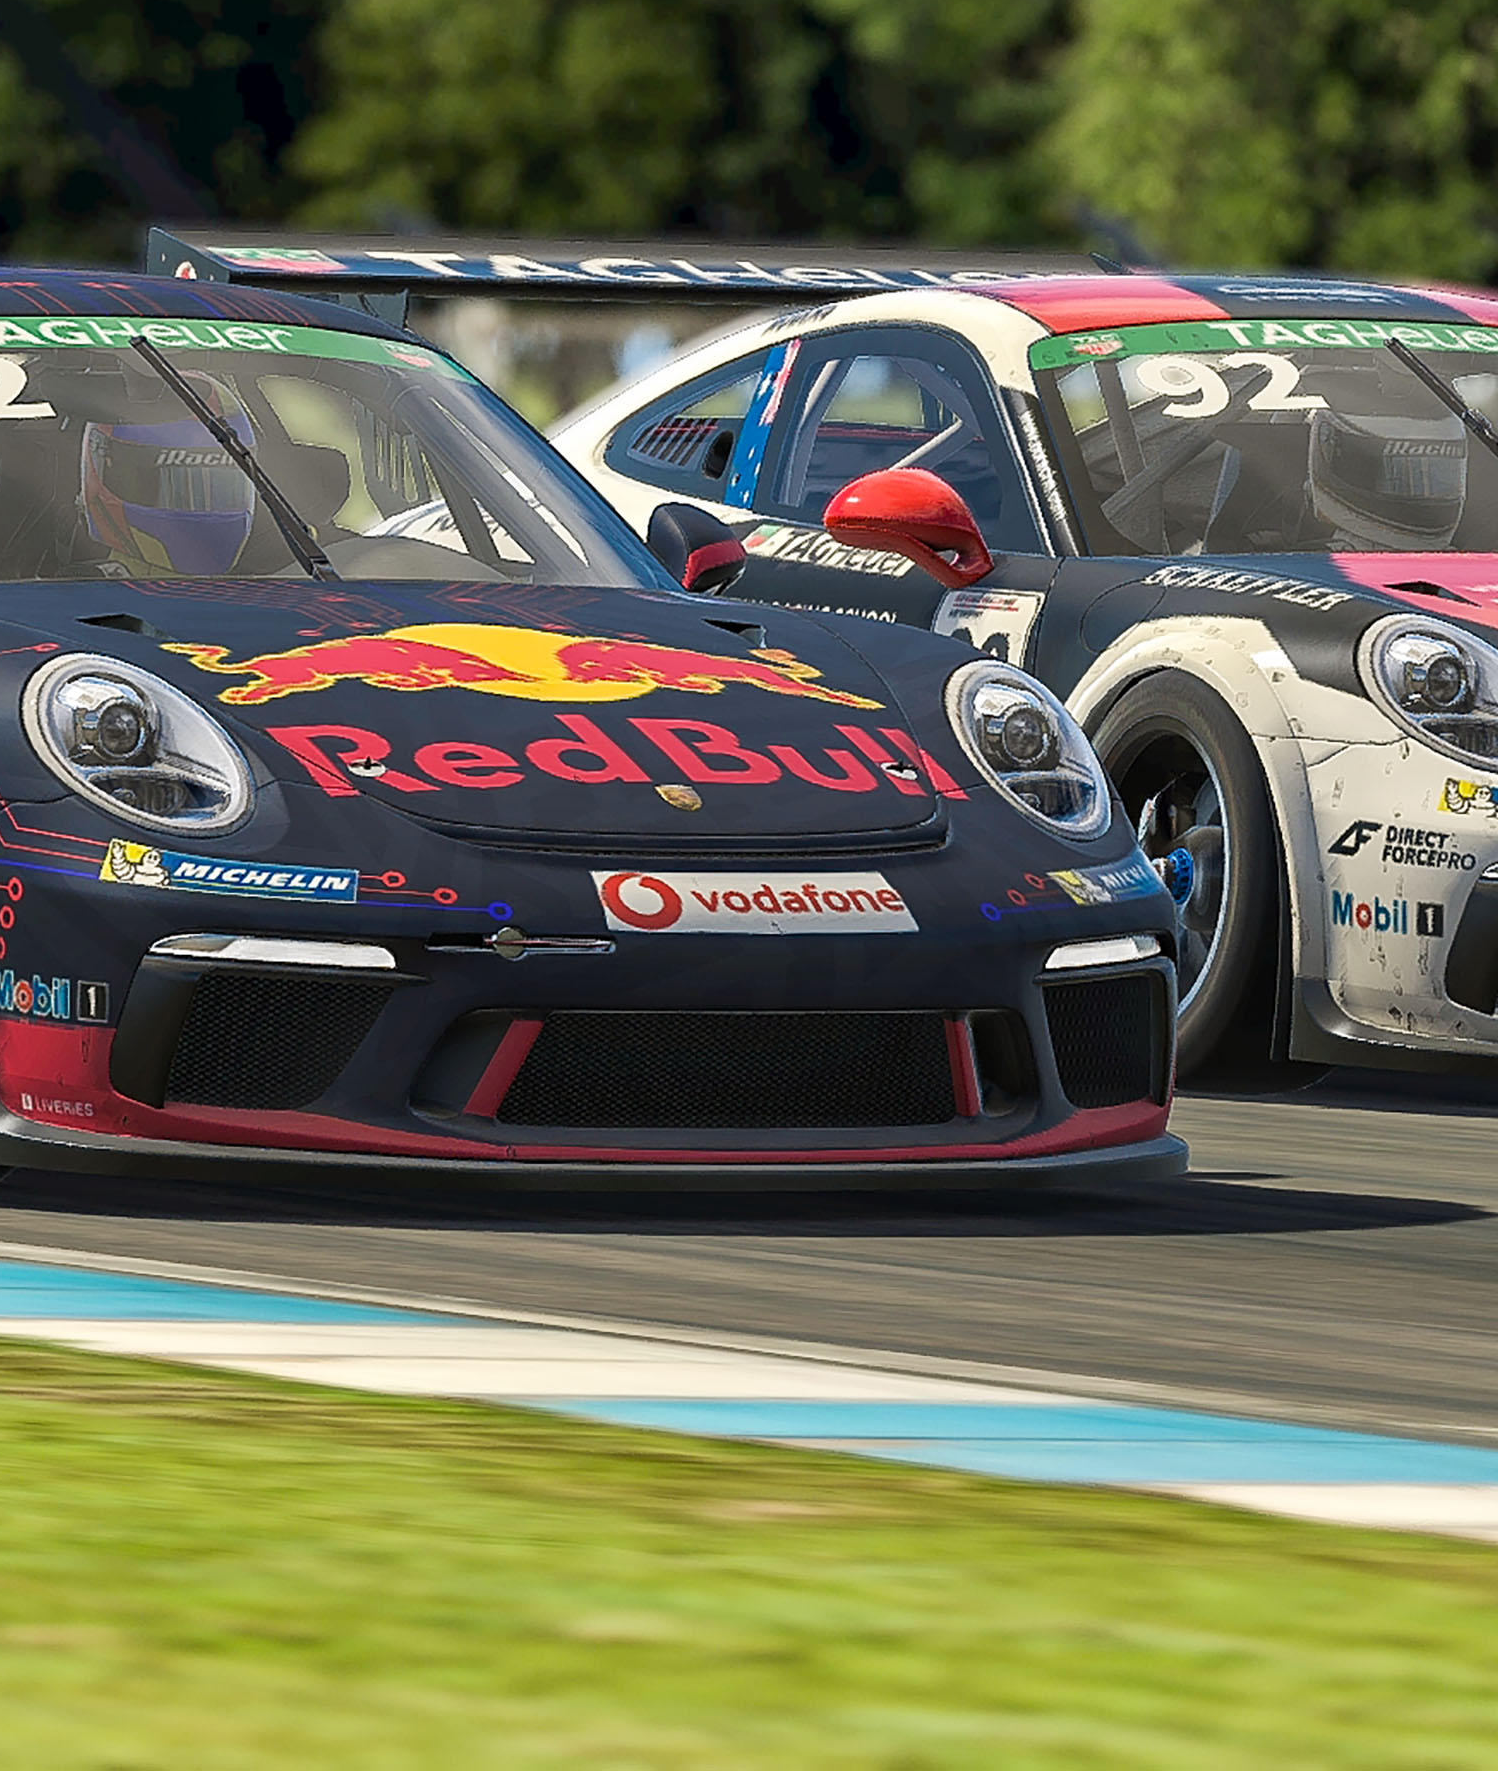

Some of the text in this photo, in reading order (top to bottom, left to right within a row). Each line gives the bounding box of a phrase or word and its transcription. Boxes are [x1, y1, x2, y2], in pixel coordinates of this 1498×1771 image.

[1135, 351, 1331, 419] 92
[155, 449, 237, 467] iRaci
[267, 714, 970, 799] Red Bull
[1385, 825, 1450, 850] DIRECT
[1382, 845, 1476, 871] FORCEPRO
[174, 861, 350, 890] MICHELIN
[690, 882, 905, 915] vodafone
[1331, 889, 1408, 935] Mobil
